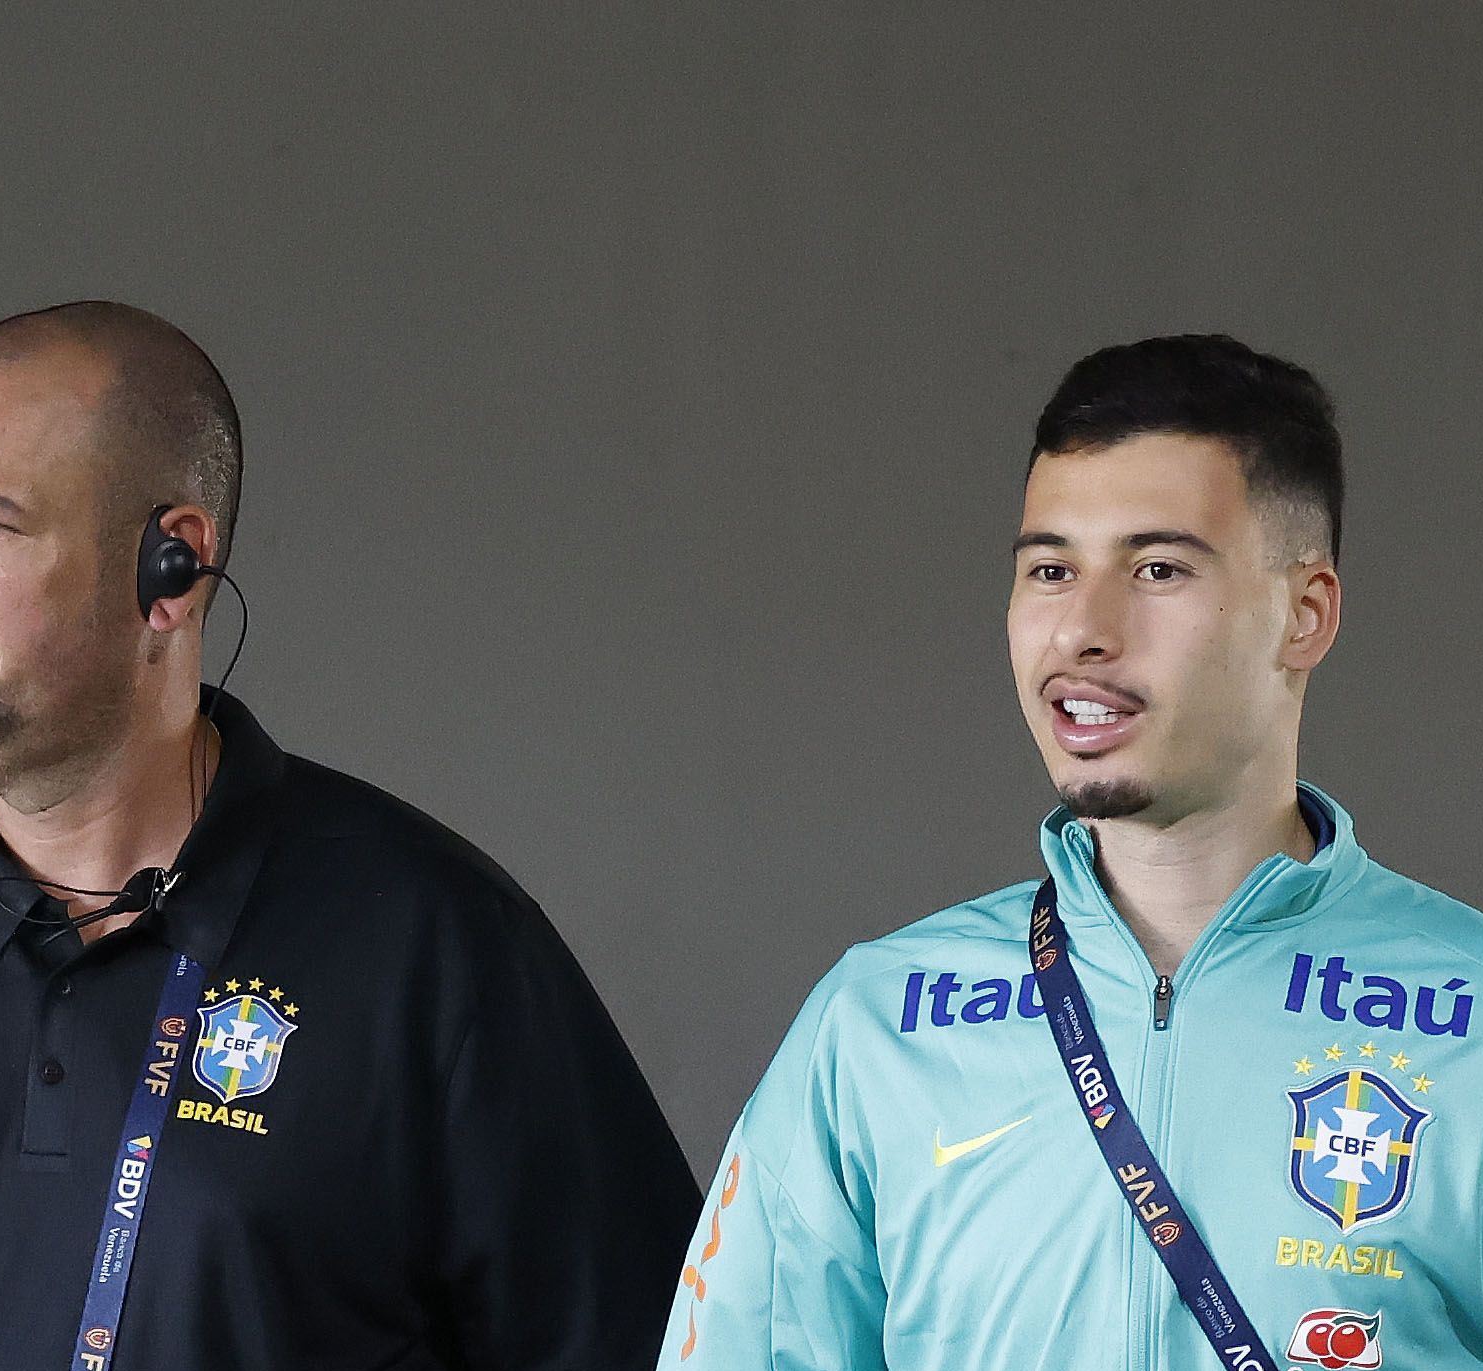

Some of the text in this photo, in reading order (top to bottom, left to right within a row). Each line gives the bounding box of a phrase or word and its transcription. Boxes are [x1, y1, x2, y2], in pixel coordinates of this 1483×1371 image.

[1284, 952, 1475, 1038] Itaú
[144, 1040, 180, 1097] FVF
[223, 1036, 257, 1052] CBF
[1071, 1053, 1108, 1107] BDV
[176, 1099, 269, 1135] BRASIL
[1329, 1134, 1376, 1157] CBF
[114, 1158, 146, 1220] BDV
[1117, 1162, 1169, 1223] FVF
[1275, 1236, 1404, 1280] BRASIL
